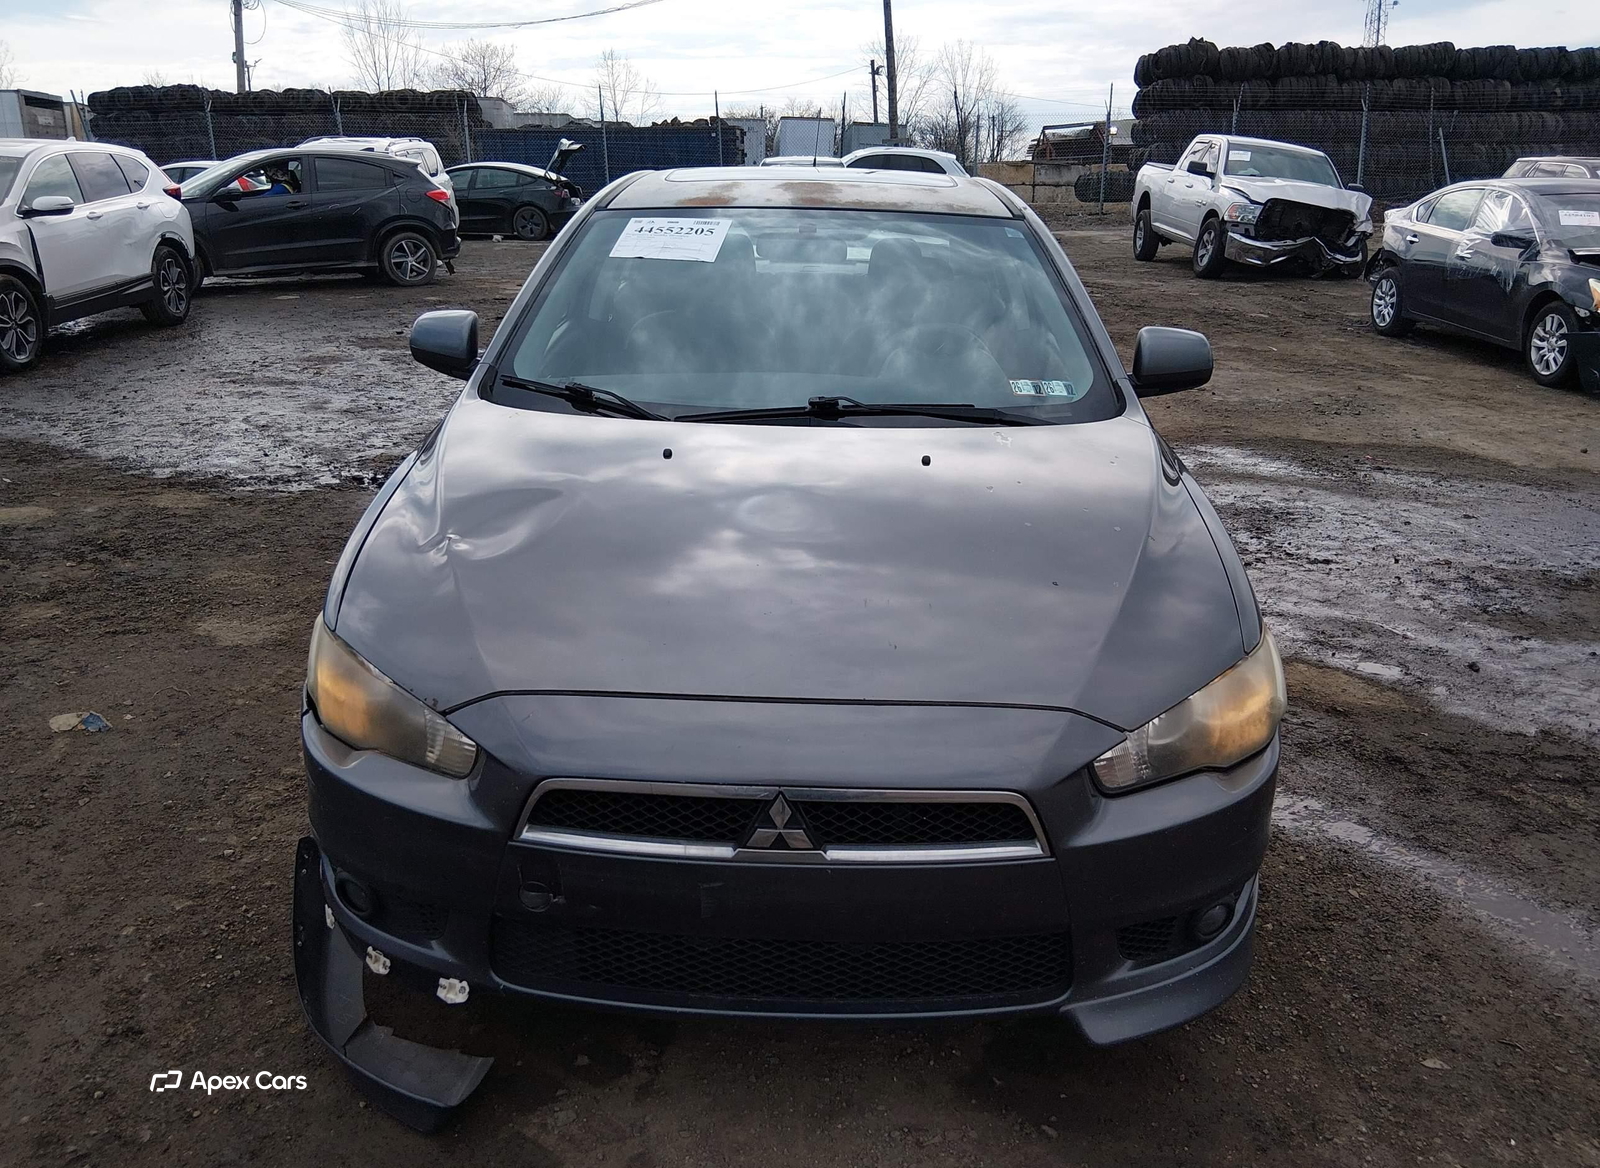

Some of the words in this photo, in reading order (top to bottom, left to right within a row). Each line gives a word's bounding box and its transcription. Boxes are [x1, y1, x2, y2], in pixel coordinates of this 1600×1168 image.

[634, 226, 715, 236] 44552205
[1011, 381, 1023, 393] 26
[1043, 382, 1055, 394] 26
